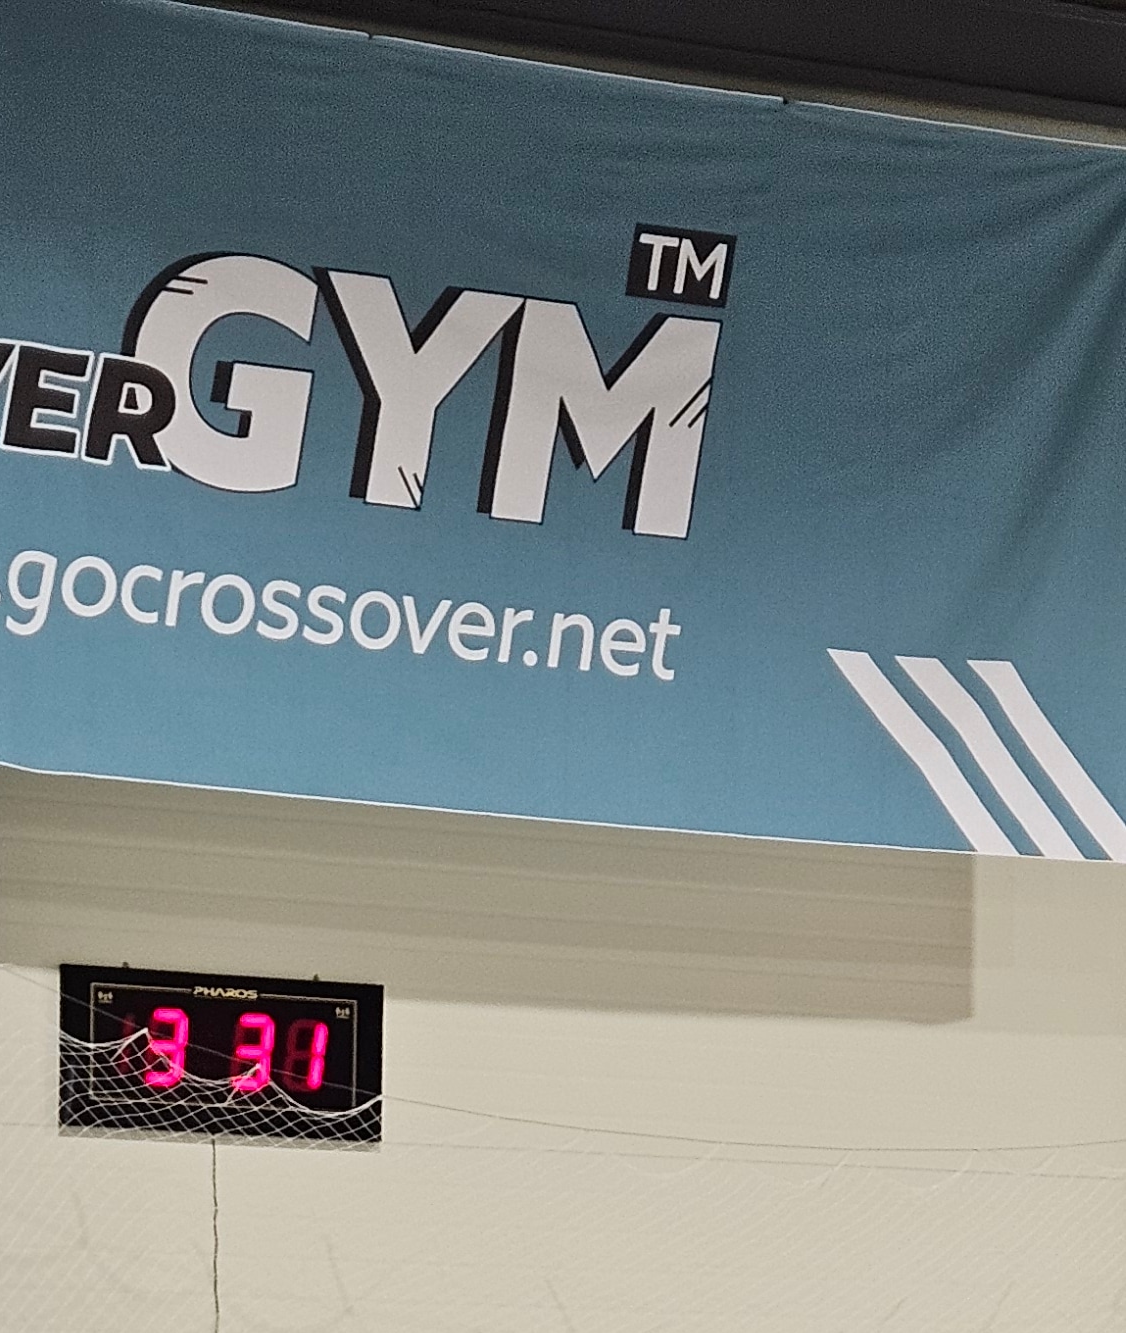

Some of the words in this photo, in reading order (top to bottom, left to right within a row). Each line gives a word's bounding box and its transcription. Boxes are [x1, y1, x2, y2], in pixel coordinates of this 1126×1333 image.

[638, 232, 729, 301] TM
[123, 250, 723, 540] GYM
[193, 985, 258, 999] PHAROS
[144, 1007, 189, 1087] 3
[231, 1012, 329, 1091] 31
